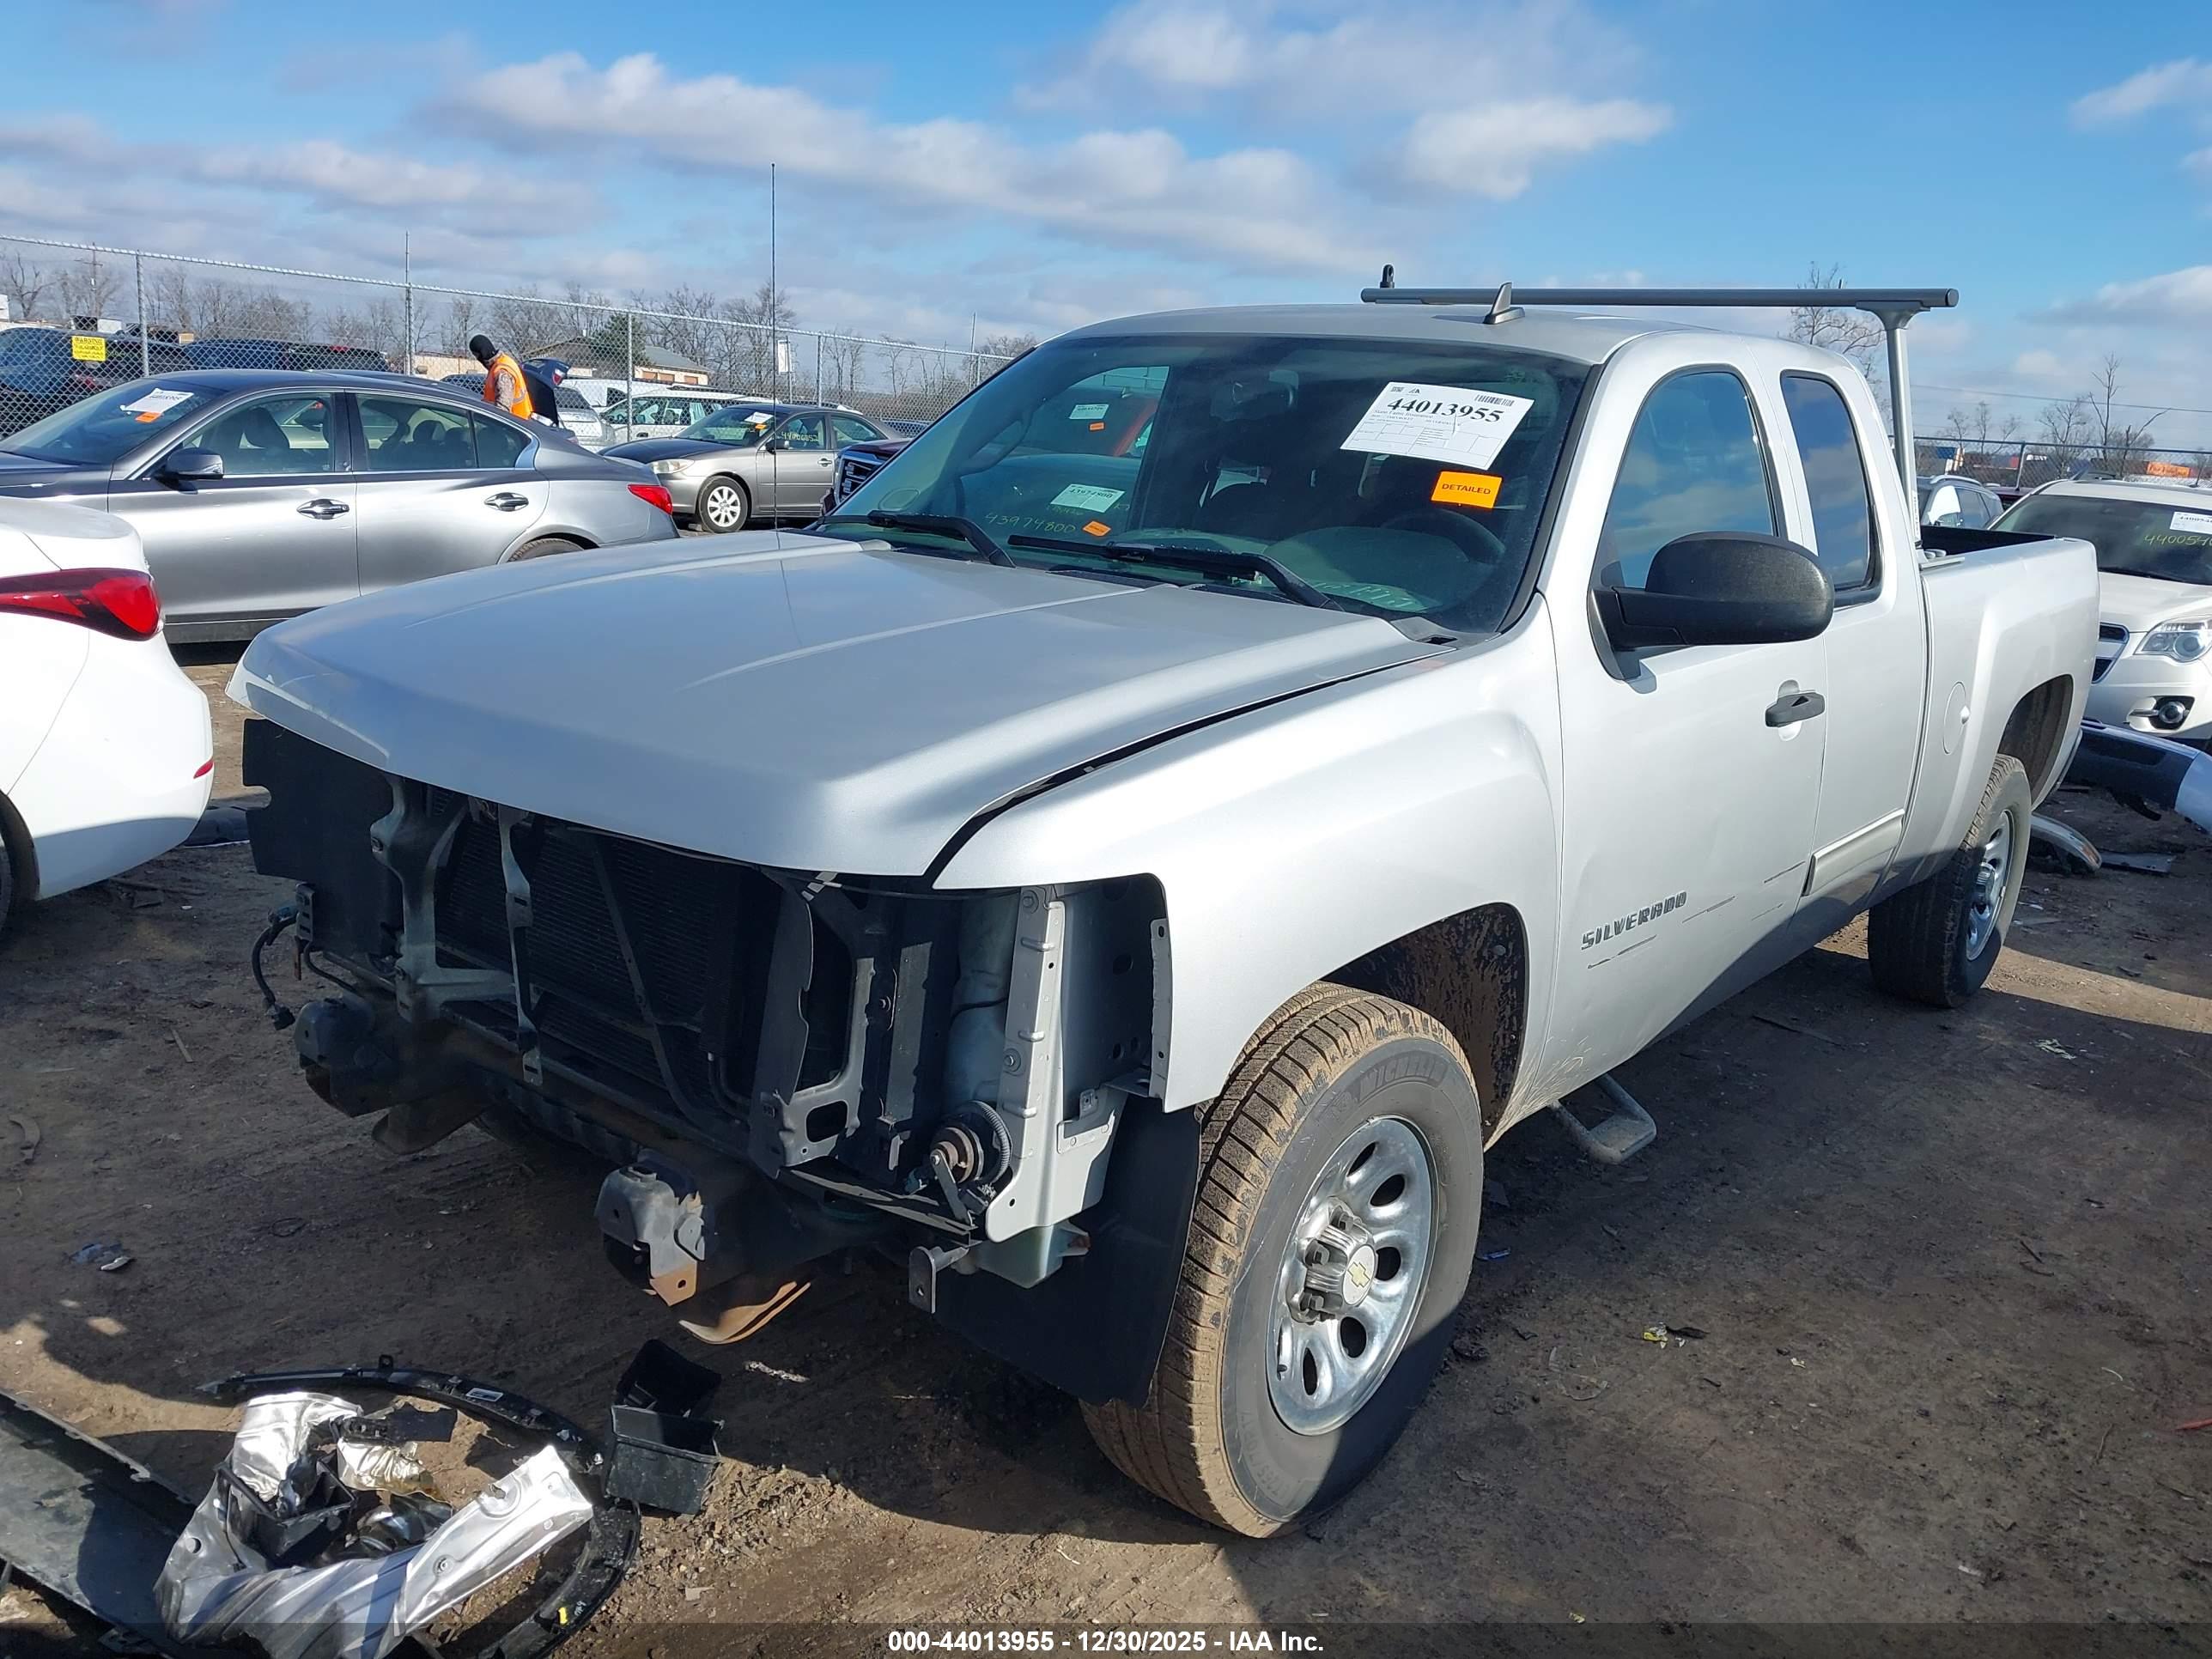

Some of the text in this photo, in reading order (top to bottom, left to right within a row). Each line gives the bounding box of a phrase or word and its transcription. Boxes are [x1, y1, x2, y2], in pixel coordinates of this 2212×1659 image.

[1387, 398, 1504, 422] 44013955
[1442, 483, 1492, 495] DETAILED
[985, 513, 1076, 533] 43974800
[1581, 891, 1688, 951] SILVERADO
